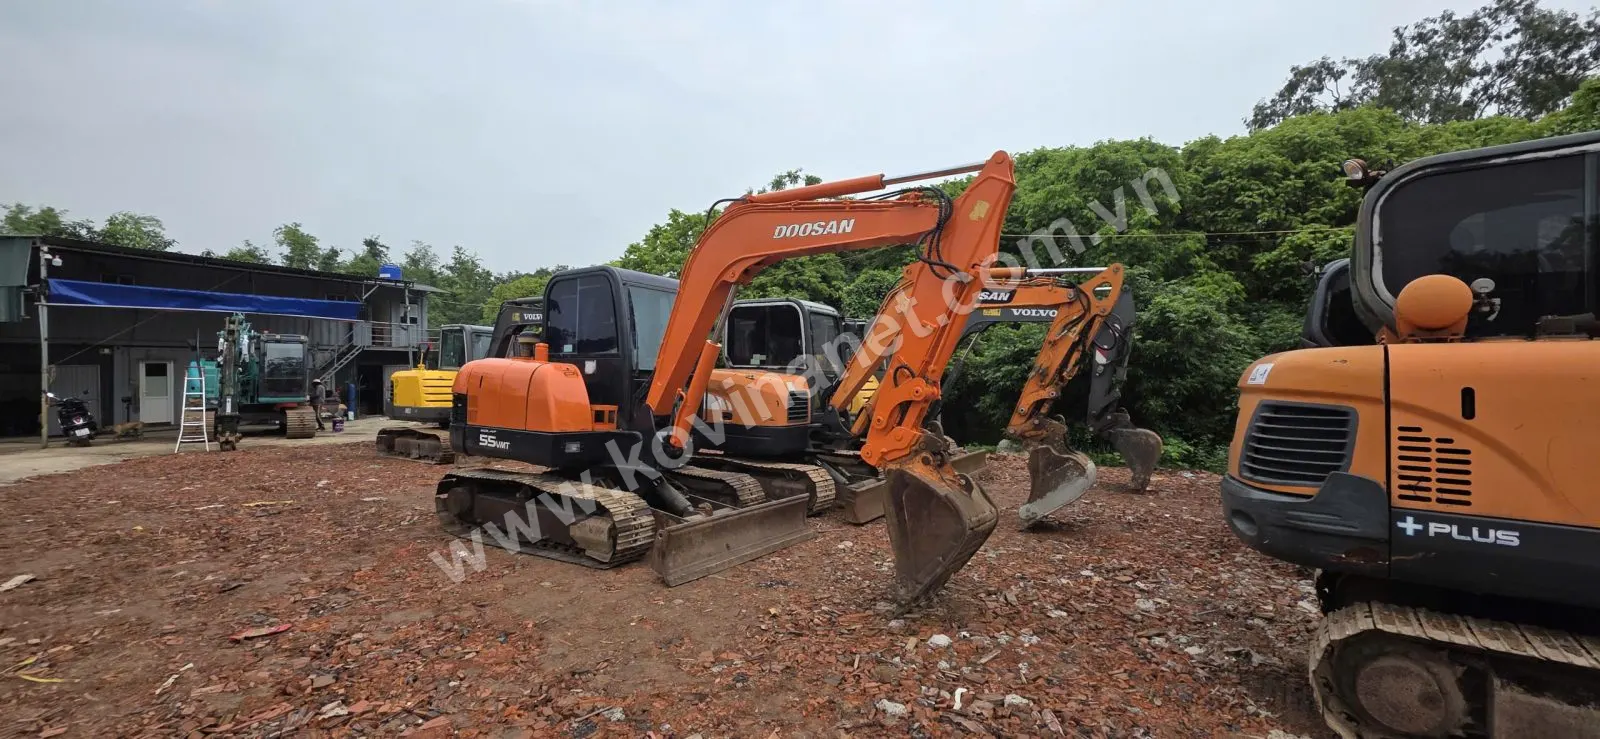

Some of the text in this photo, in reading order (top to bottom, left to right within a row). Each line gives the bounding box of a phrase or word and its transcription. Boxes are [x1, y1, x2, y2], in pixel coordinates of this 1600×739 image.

[773, 219, 855, 238] DOOSAN
[978, 291, 1011, 301] SAN
[1011, 308, 1058, 317] VOLVO
